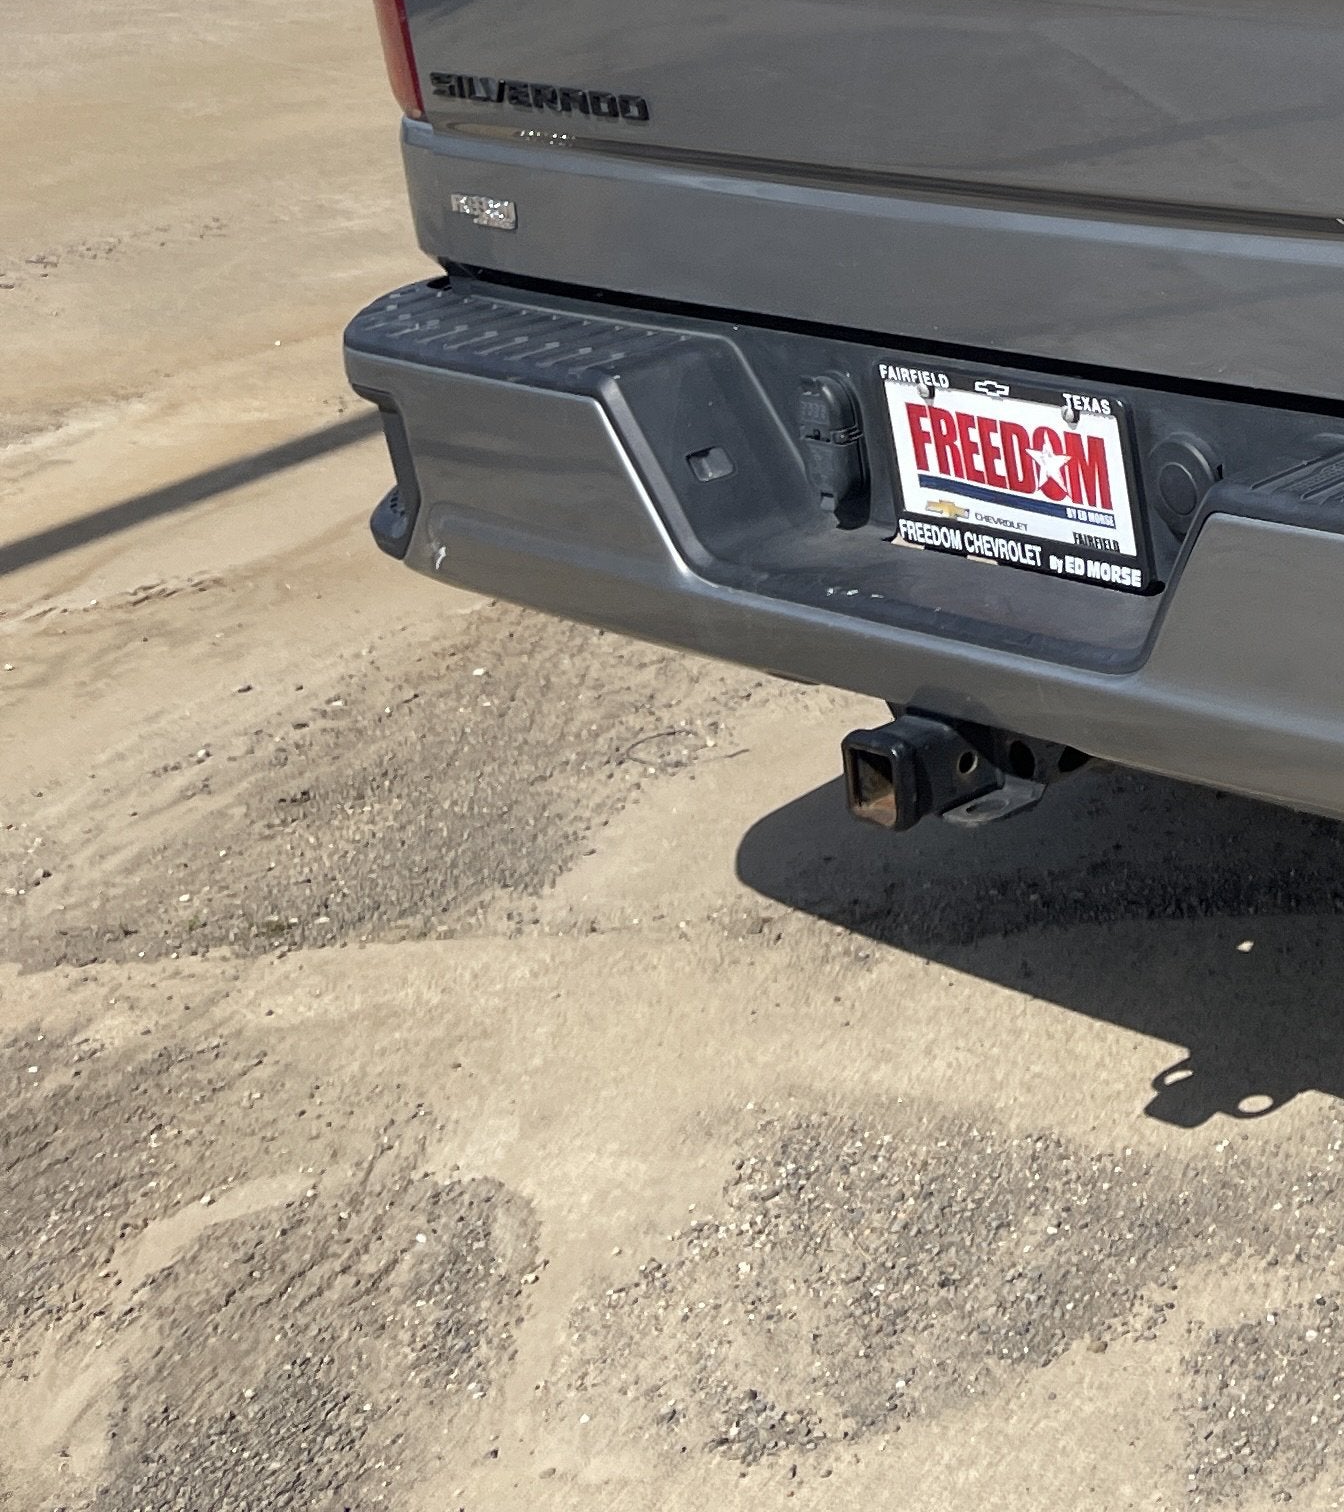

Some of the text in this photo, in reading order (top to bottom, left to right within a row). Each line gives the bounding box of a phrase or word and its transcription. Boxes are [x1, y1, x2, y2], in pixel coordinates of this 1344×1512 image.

[430, 71, 650, 121] SILVERADO
[879, 364, 949, 389] FAIRFIELD
[1062, 393, 1111, 415] TEXAS
[905, 402, 1113, 510] FREEDOM
[975, 513, 1028, 531] CHEVROLET
[898, 519, 963, 551] FREEDOM
[964, 533, 1042, 567] CHEVROLET
[1064, 555, 1085, 576] ED
[1086, 559, 1142, 588] MORSE
[1073, 532, 1120, 553] FAIRFIELD
